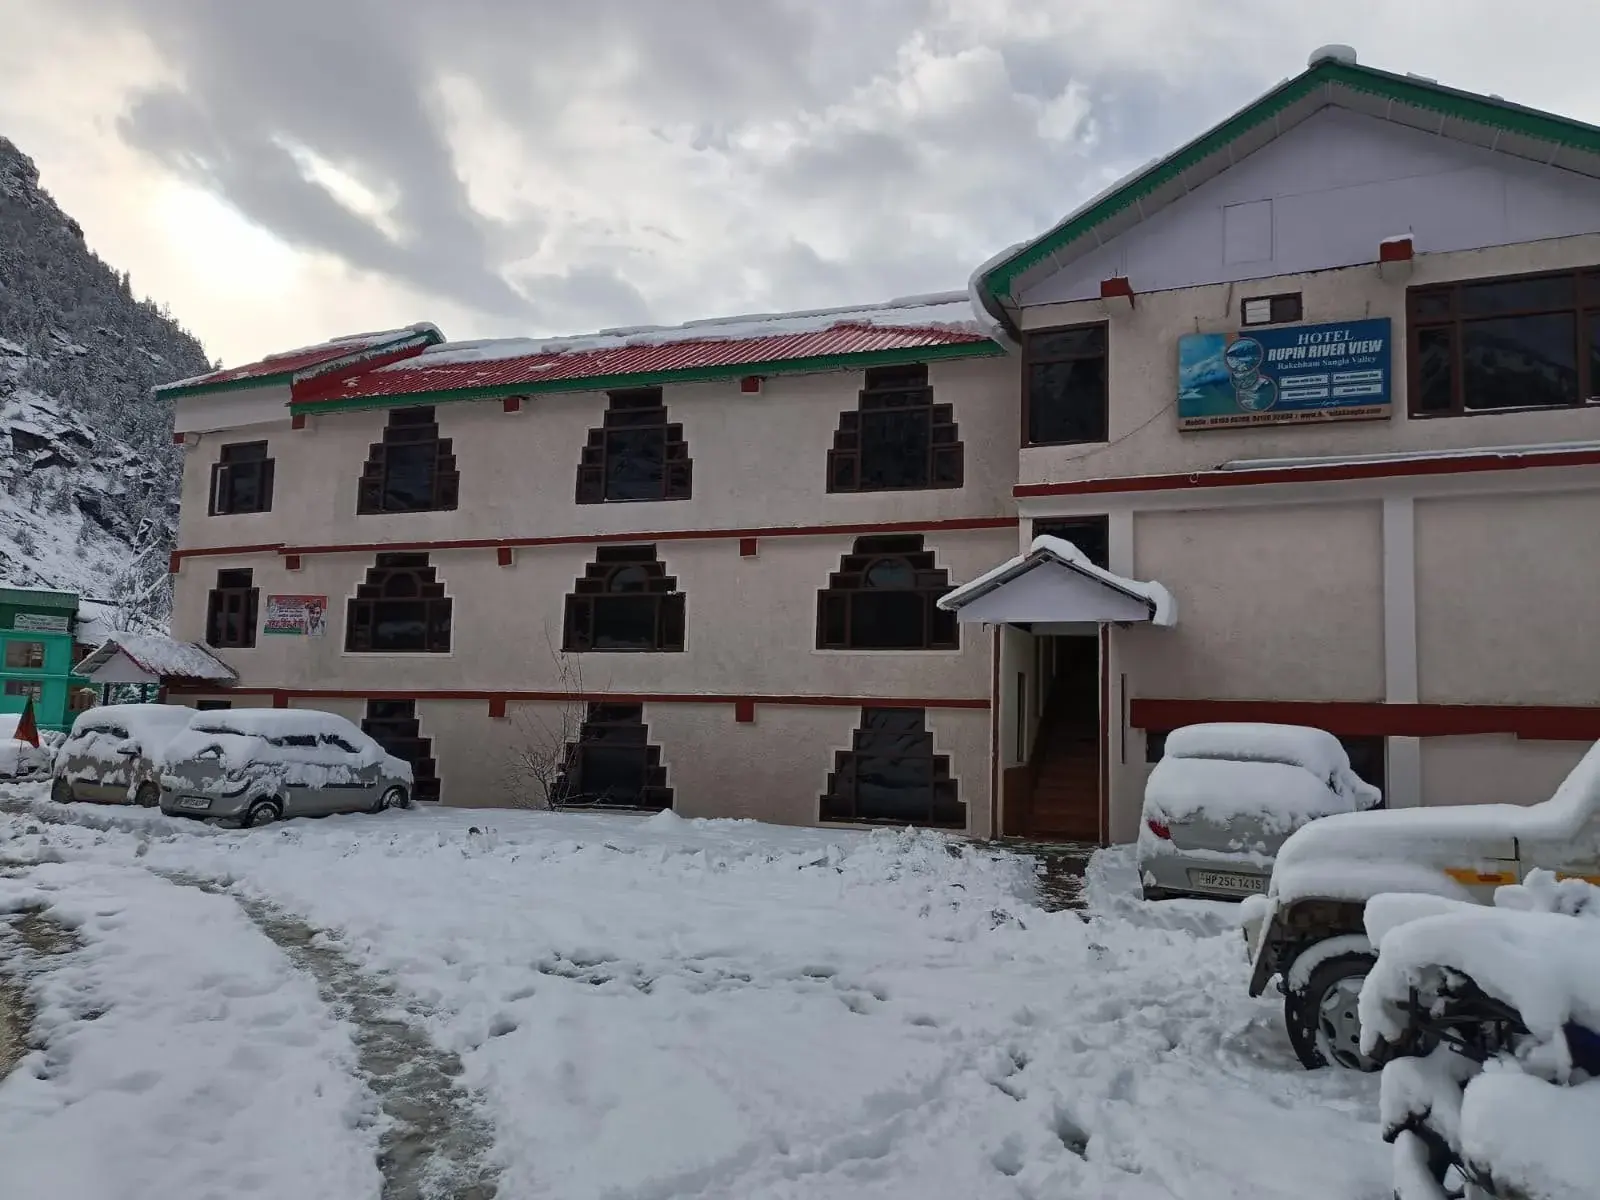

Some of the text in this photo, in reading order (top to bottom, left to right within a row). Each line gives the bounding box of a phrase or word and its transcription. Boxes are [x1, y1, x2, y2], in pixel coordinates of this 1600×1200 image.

[1298, 330, 1354, 345] HOTEL
[1268, 339, 1383, 361] RUPIN RIVER VIEW
[1322, 357, 1349, 368] Sangla
[1352, 354, 1377, 365] Valley
[1205, 874, 1217, 885] HP
